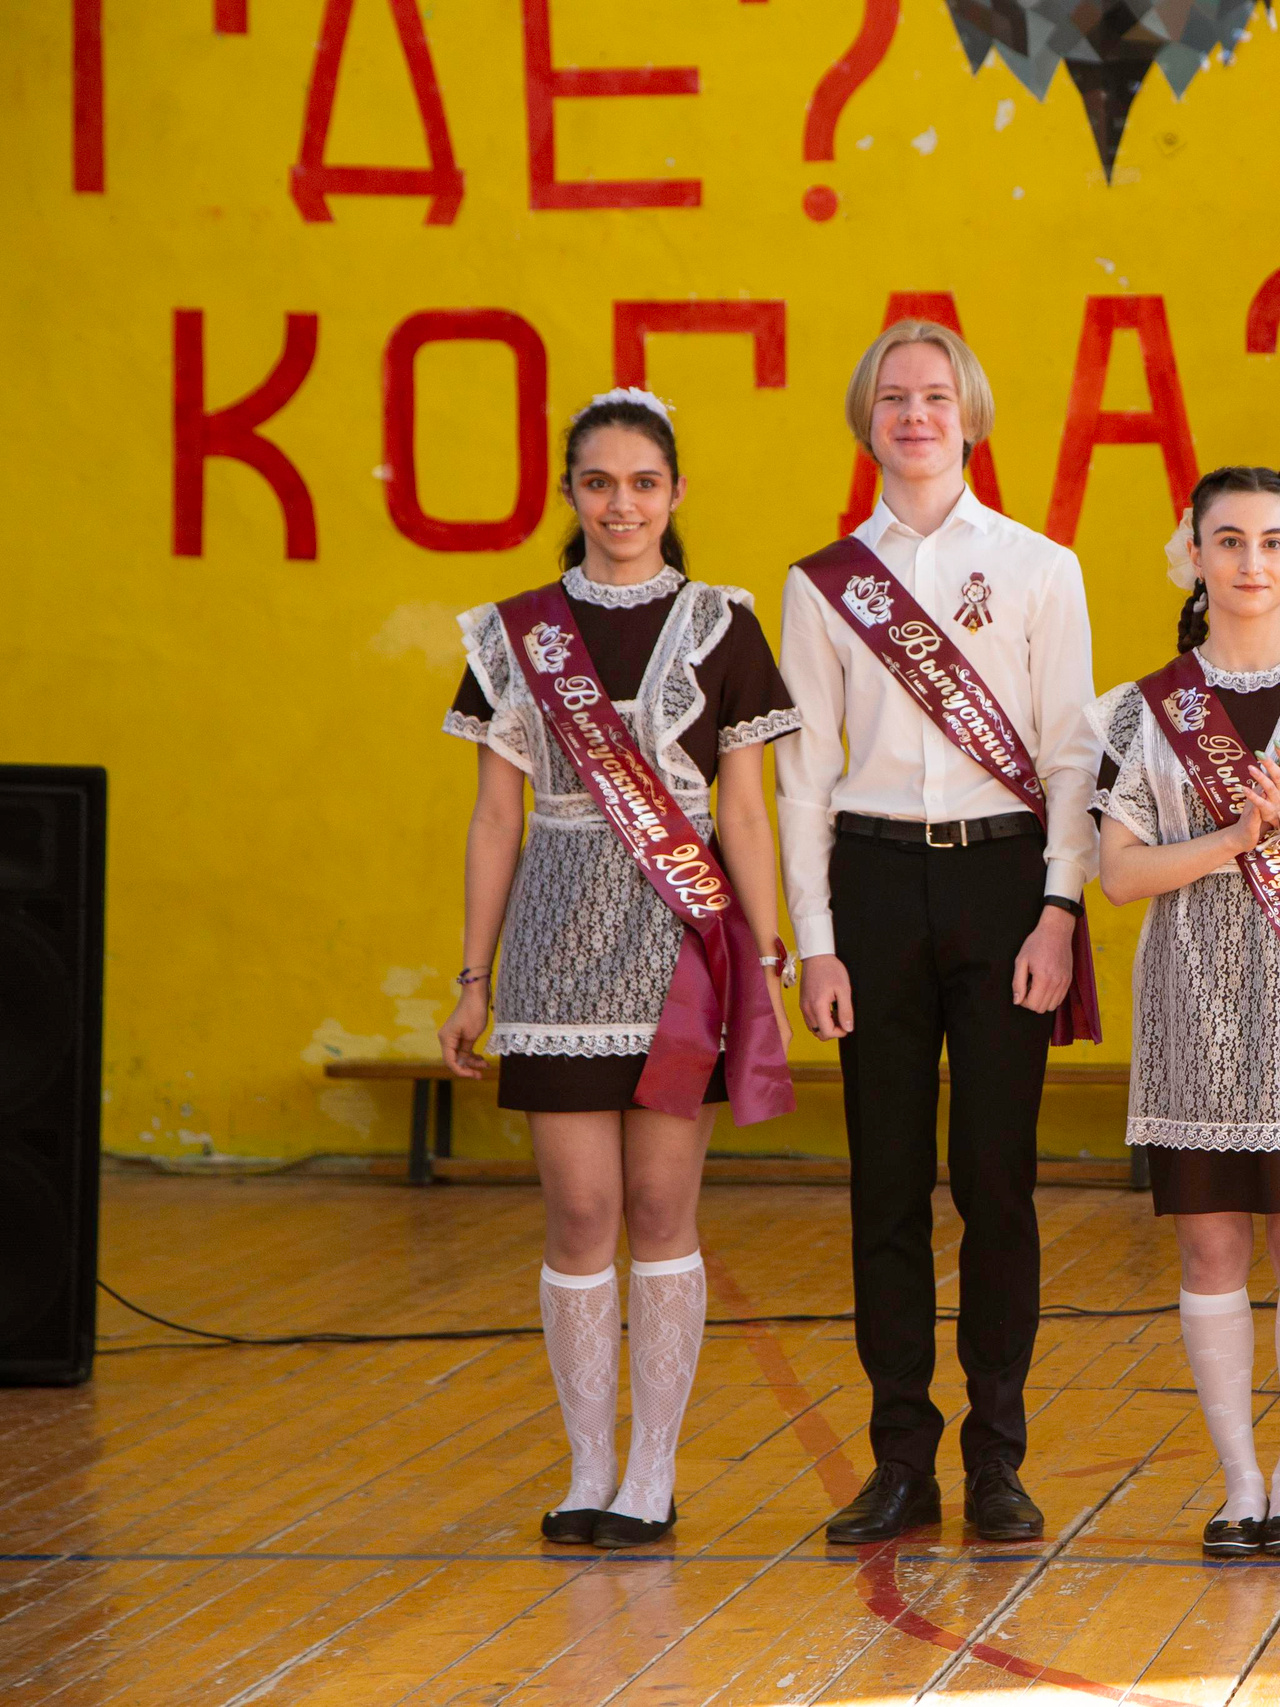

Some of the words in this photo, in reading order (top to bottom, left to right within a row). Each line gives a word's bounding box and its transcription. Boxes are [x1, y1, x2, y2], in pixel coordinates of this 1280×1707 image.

[72, 0, 901, 225] ГДЕ?
[889, 620, 1022, 780] Выпускник
[905, 669, 918, 679] 11
[554, 675, 670, 843] Выпускница
[651, 843, 731, 919] 2022
[1203, 775, 1216, 785] 11
